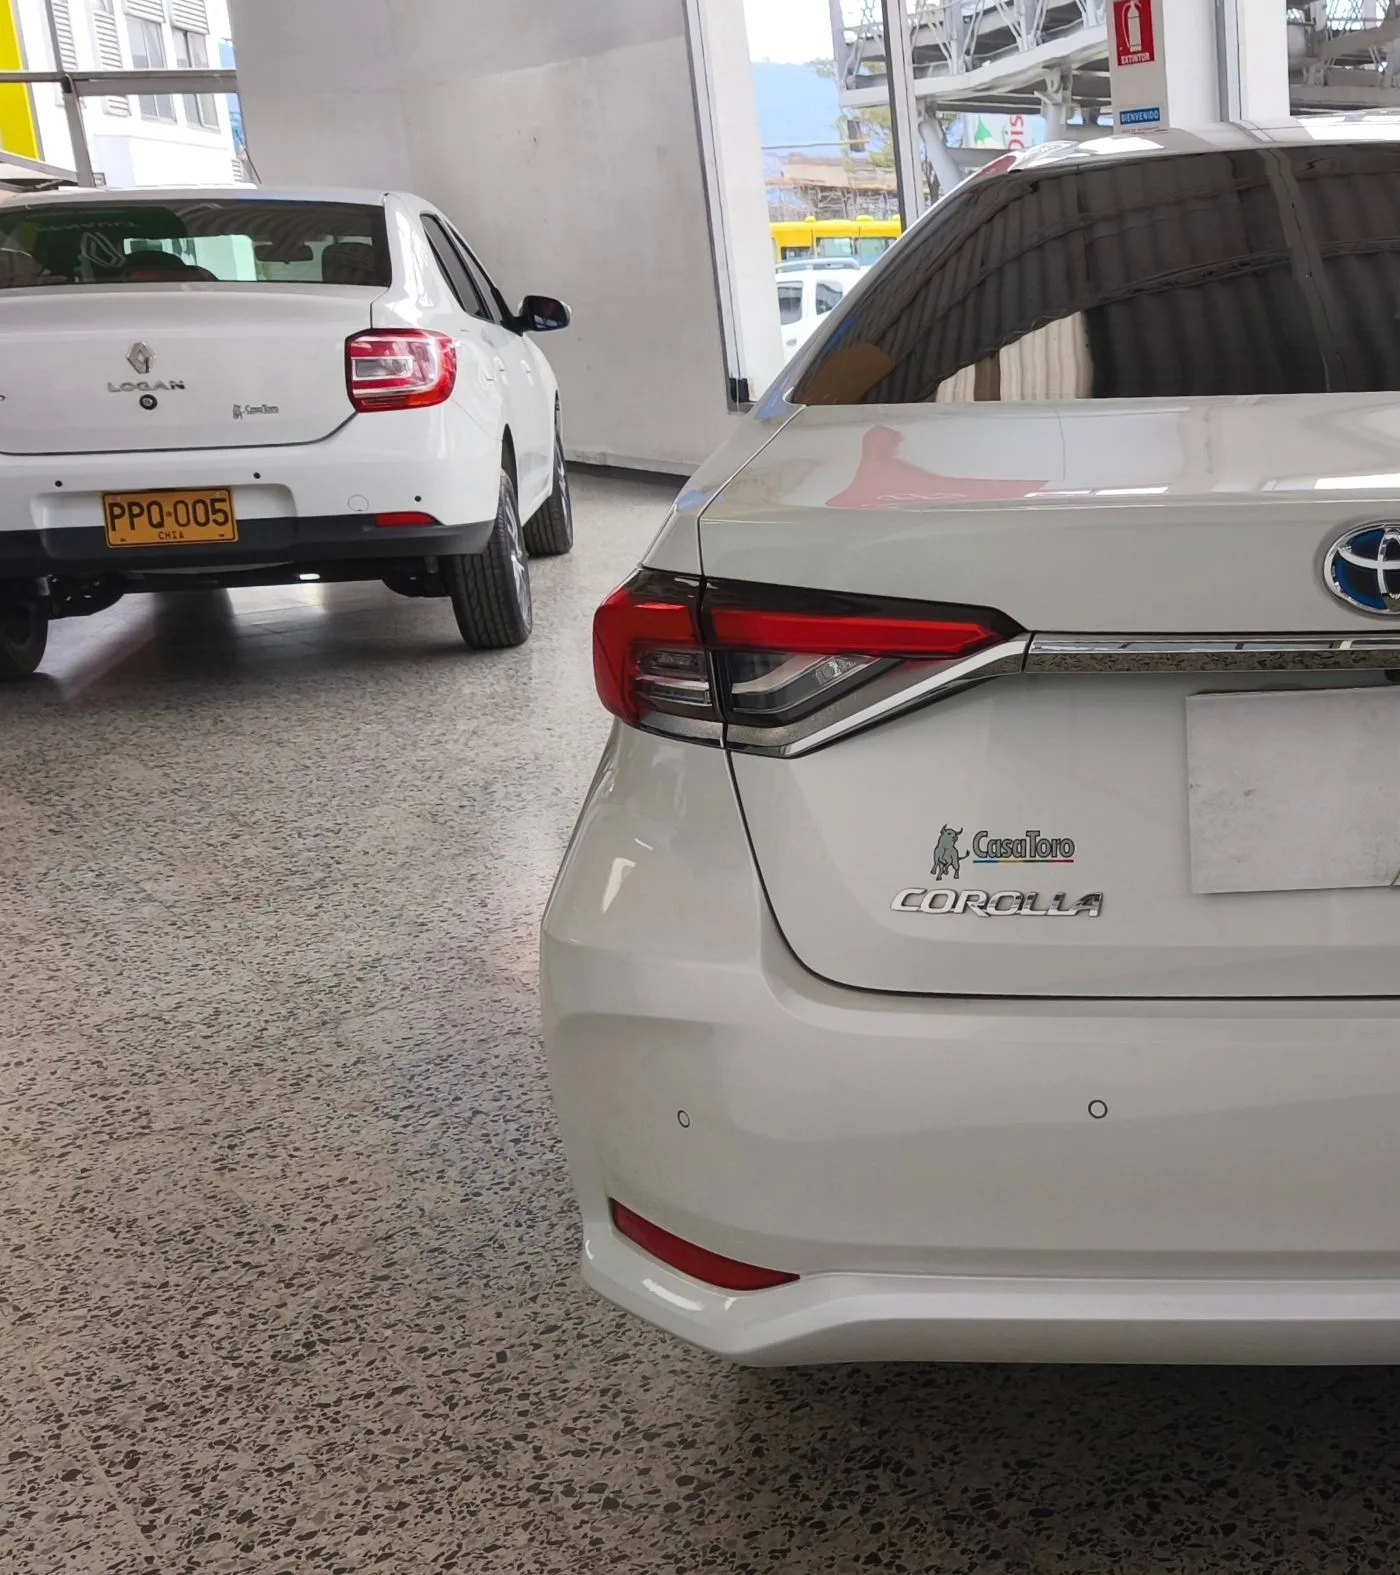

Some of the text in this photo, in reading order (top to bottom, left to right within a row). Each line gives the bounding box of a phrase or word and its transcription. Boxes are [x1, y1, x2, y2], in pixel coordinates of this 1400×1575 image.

[1120, 52, 1151, 64] EXTINTOR
[1121, 110, 1159, 123] BIENVENIDO
[108, 380, 185, 393] LOGAN
[158, 530, 184, 540] CHIA
[890, 887, 1103, 917] COROLLA
